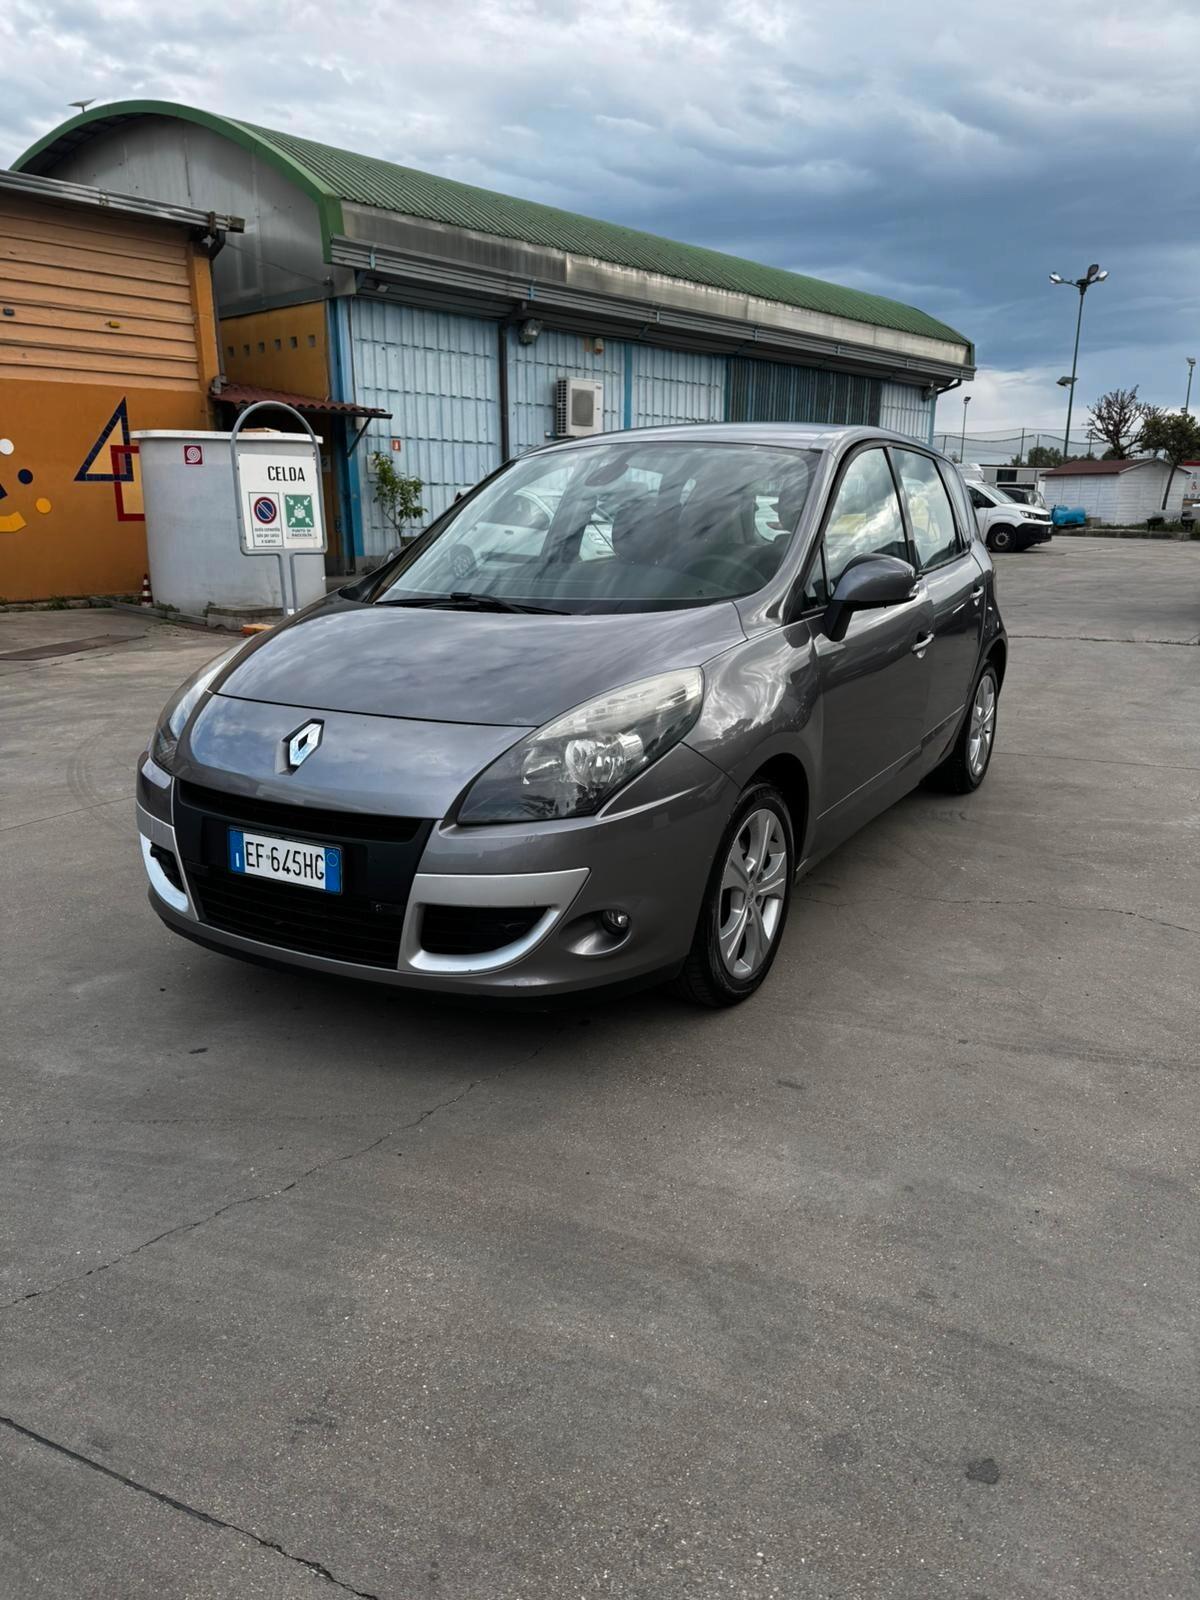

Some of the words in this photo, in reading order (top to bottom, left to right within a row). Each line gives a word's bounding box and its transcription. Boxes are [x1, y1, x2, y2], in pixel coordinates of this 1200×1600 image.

[267, 465, 306, 482] CELDA
[245, 841, 264, 868] EF
[270, 846, 325, 881] 645HG
